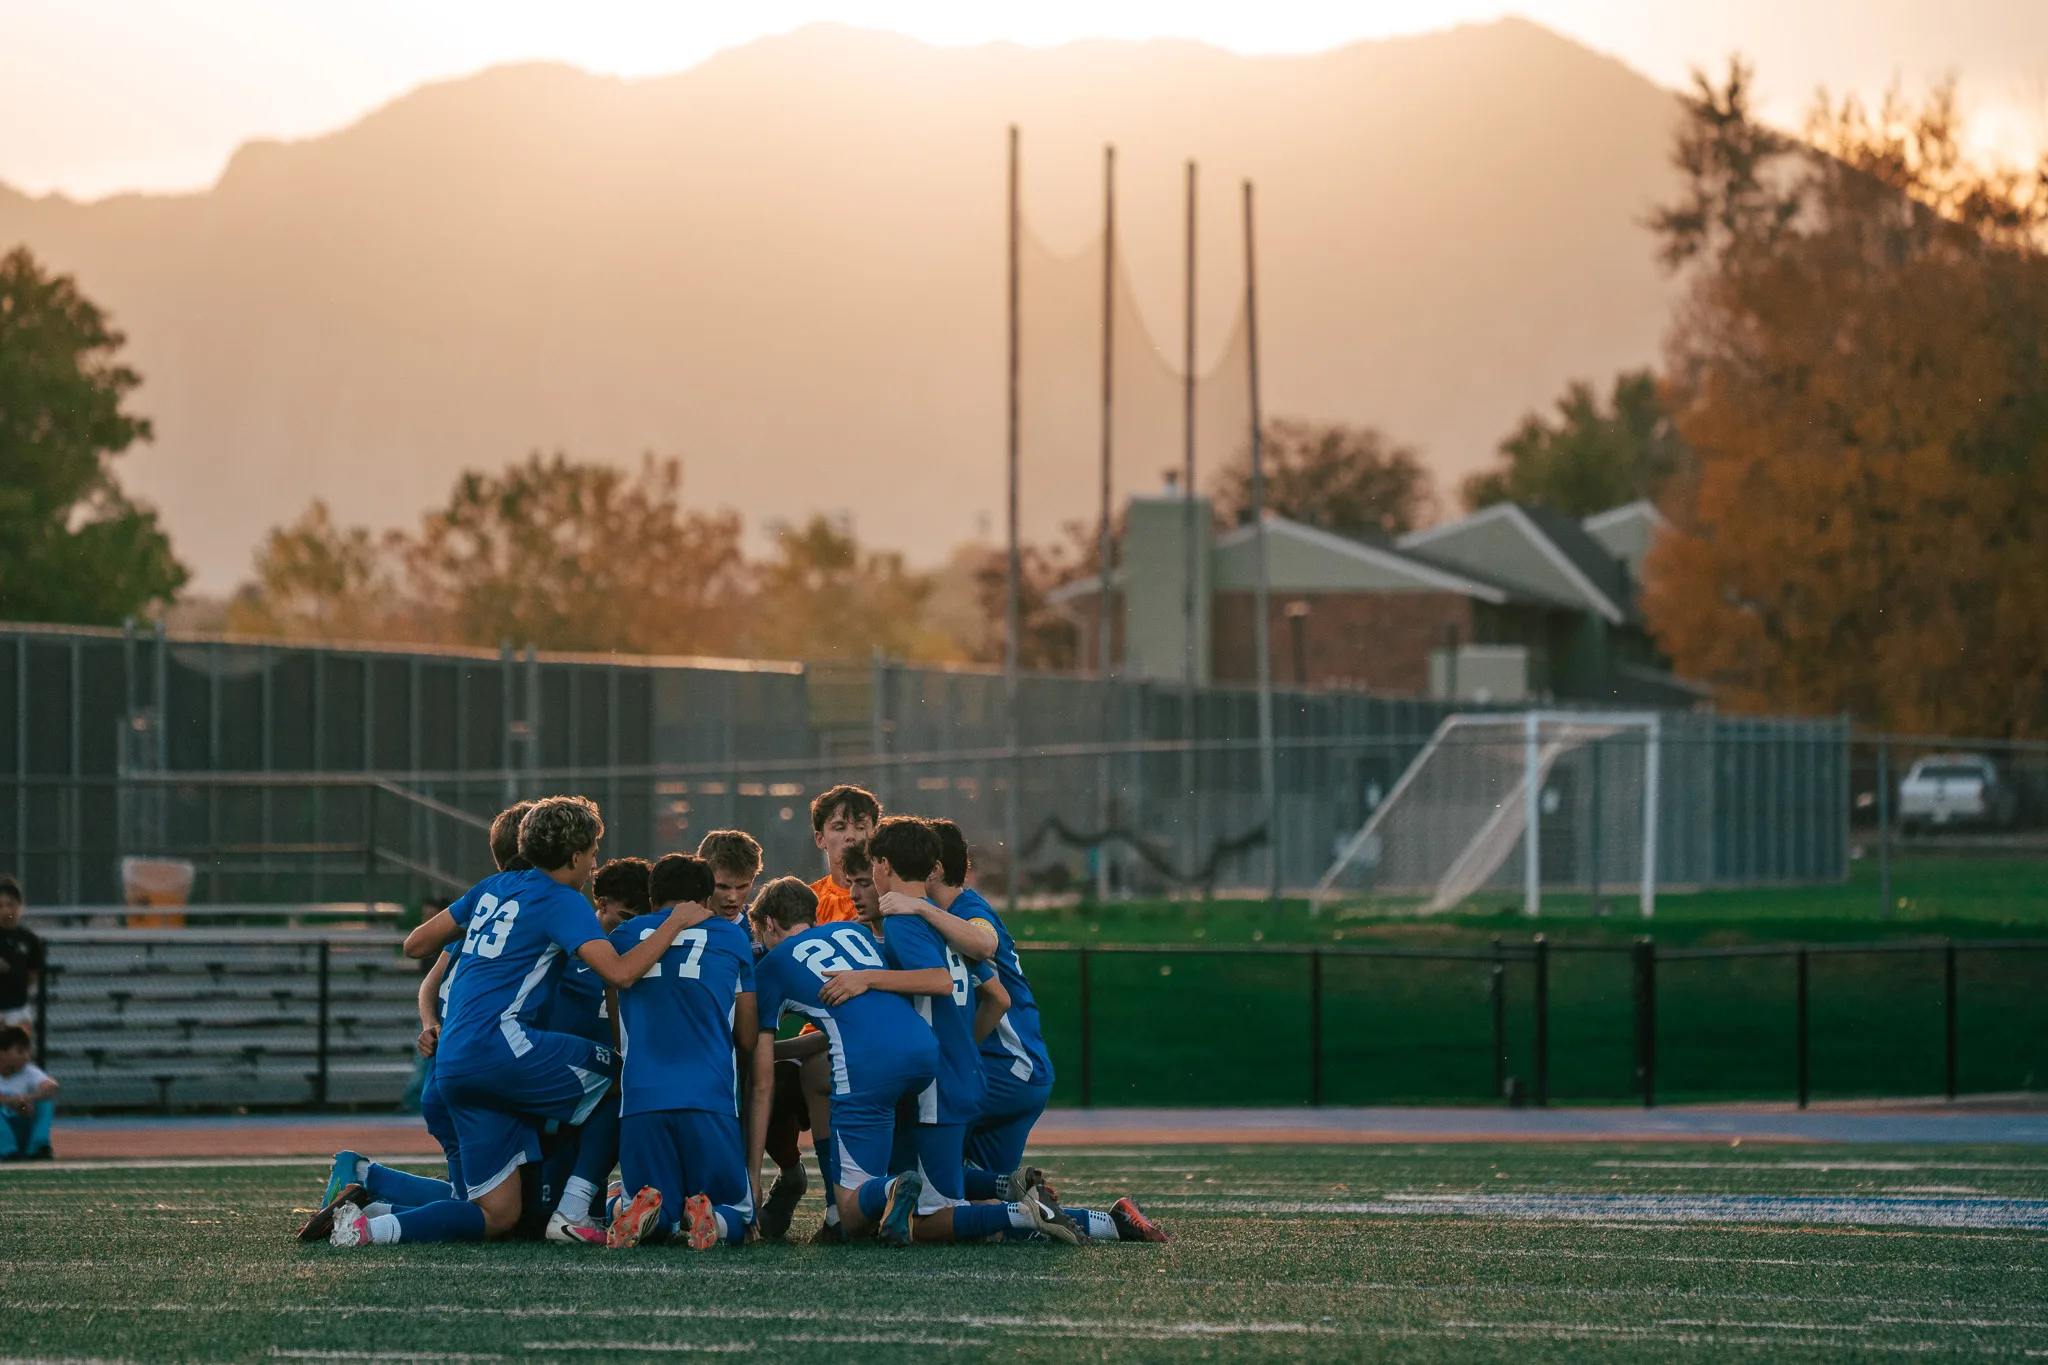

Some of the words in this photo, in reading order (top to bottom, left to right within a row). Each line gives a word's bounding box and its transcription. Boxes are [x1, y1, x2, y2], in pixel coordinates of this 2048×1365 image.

[462, 892, 519, 959] 23
[792, 929, 883, 983] 20
[595, 1045, 611, 1066] 23
